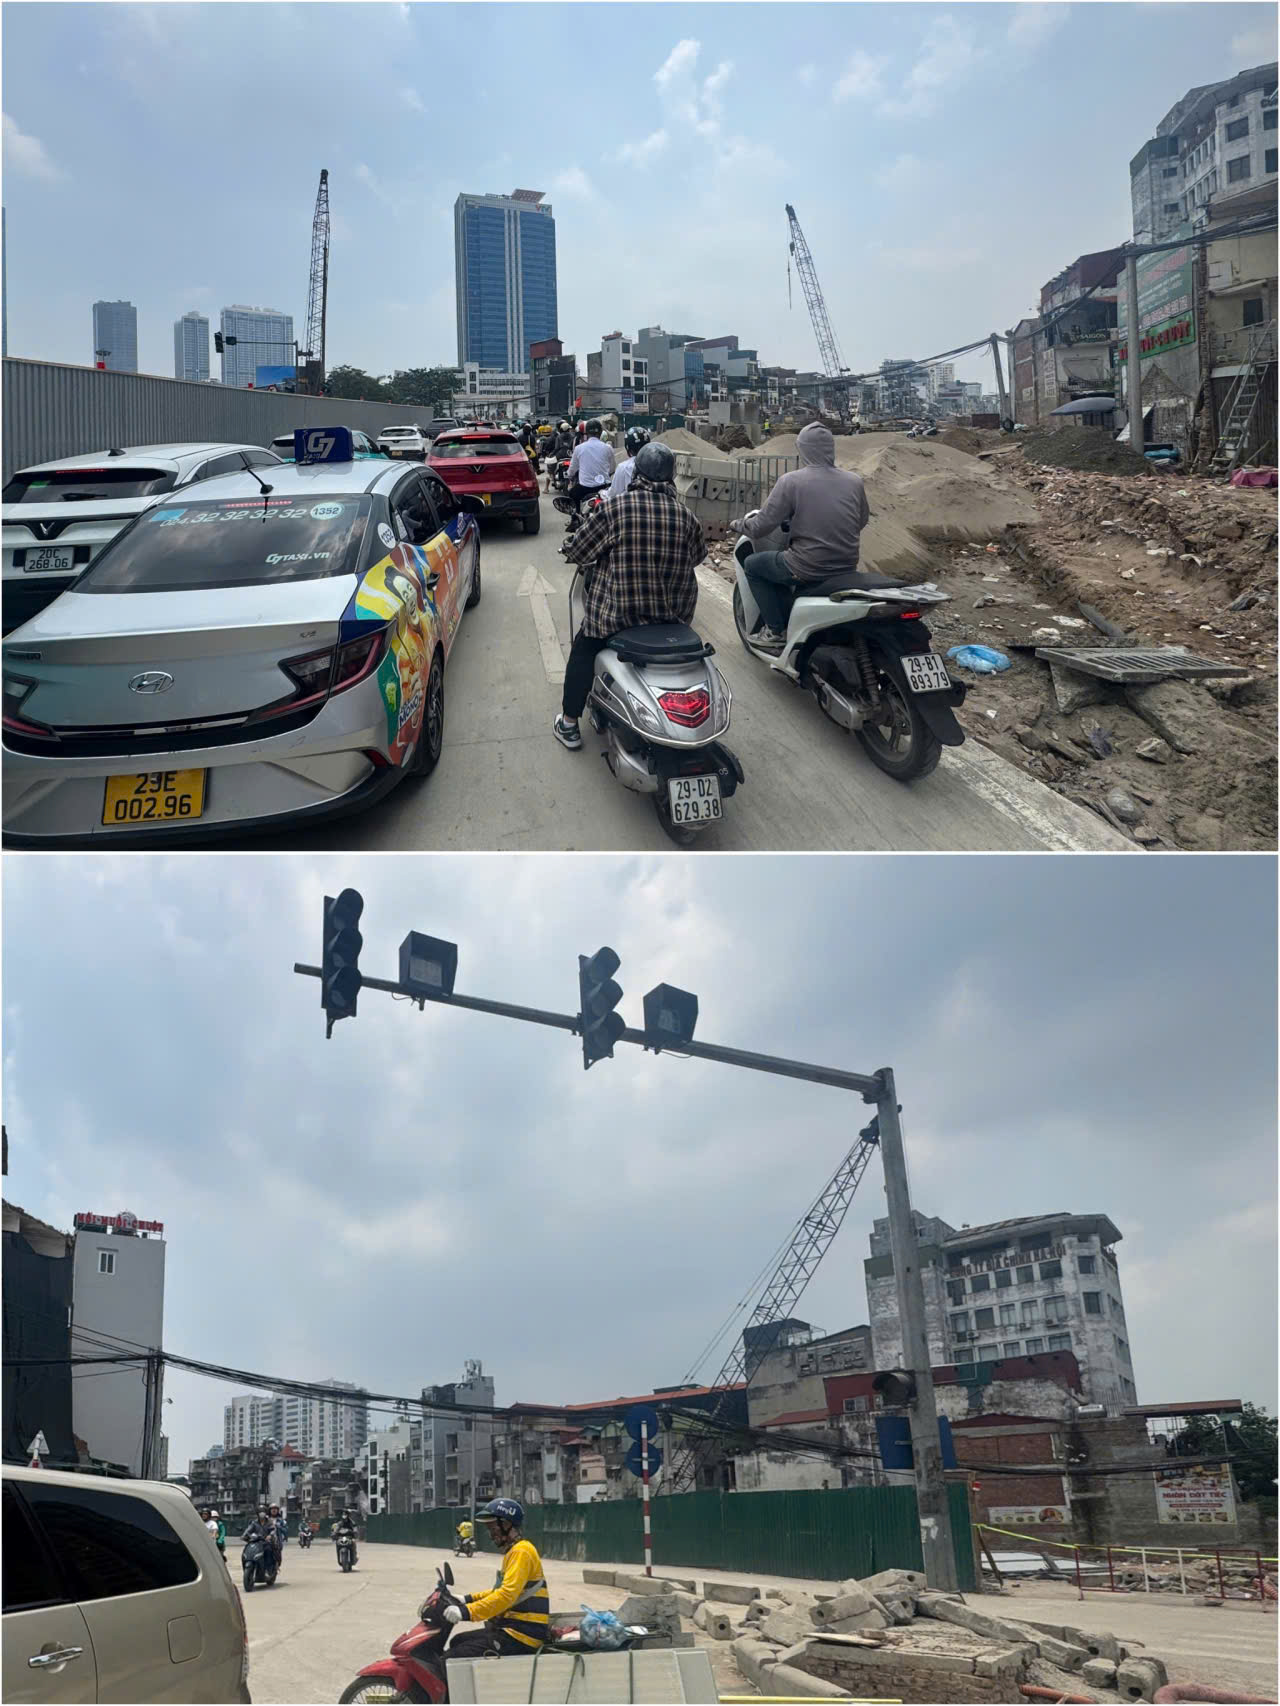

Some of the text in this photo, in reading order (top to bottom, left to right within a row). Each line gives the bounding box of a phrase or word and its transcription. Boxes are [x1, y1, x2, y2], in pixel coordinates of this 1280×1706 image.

[307, 431, 336, 459] G7
[220, 510, 248, 522] 32
[278, 508, 308, 519] 32
[314, 505, 340, 517] 1352
[39, 548, 61, 560] 20C
[907, 655, 939, 674] 29-B1
[910, 671, 949, 690] 893.79
[676, 777, 713, 801] 29-D2
[114, 794, 193, 821] 002.96
[674, 798, 720, 822] 629.38
